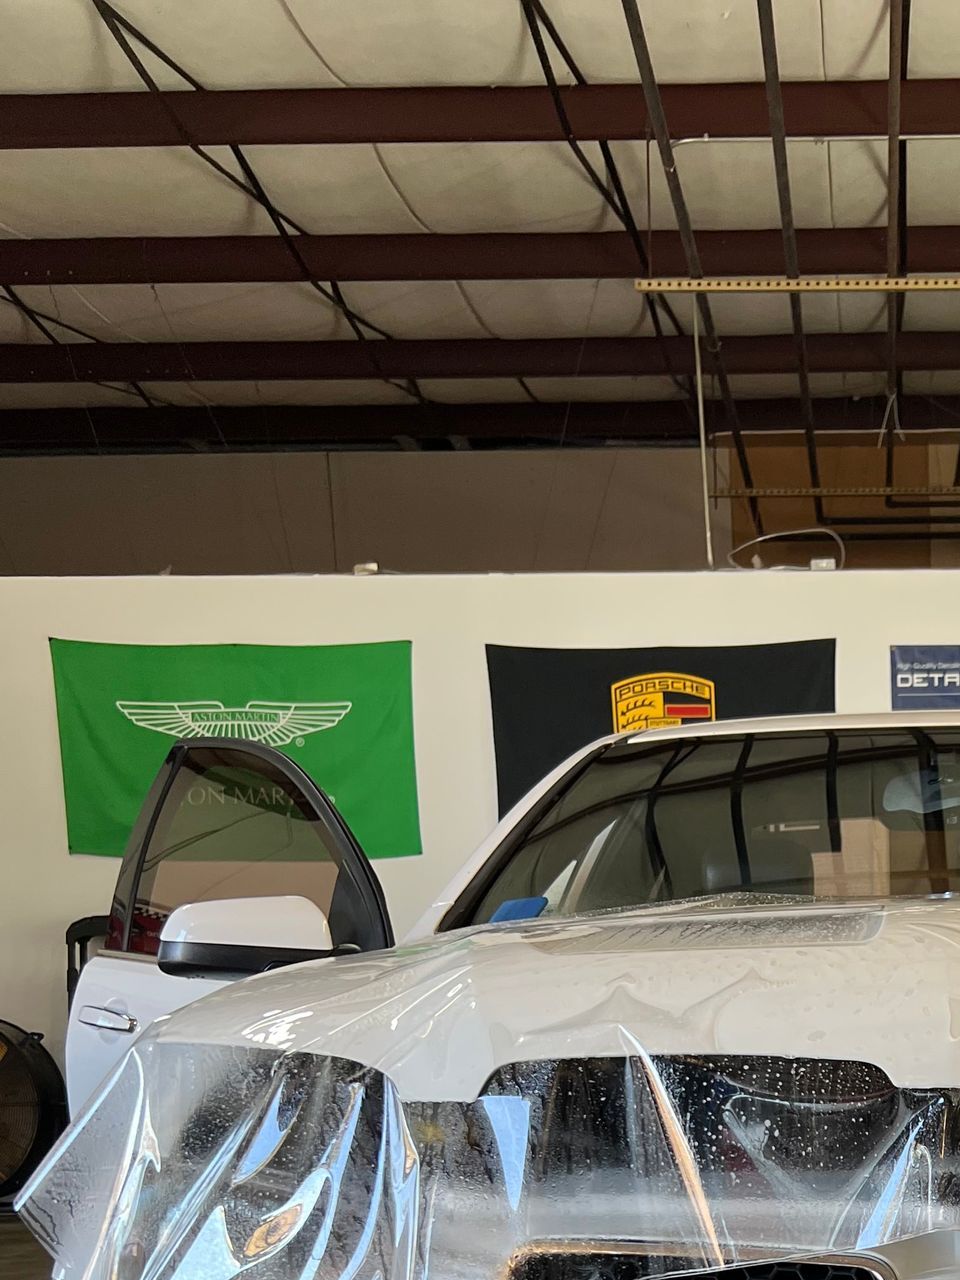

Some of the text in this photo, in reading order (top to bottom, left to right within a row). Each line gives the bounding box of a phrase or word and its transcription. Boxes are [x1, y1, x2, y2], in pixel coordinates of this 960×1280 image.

[619, 680, 706, 699] PORSCHE
[192, 712, 278, 722] ASTON MARTIN
